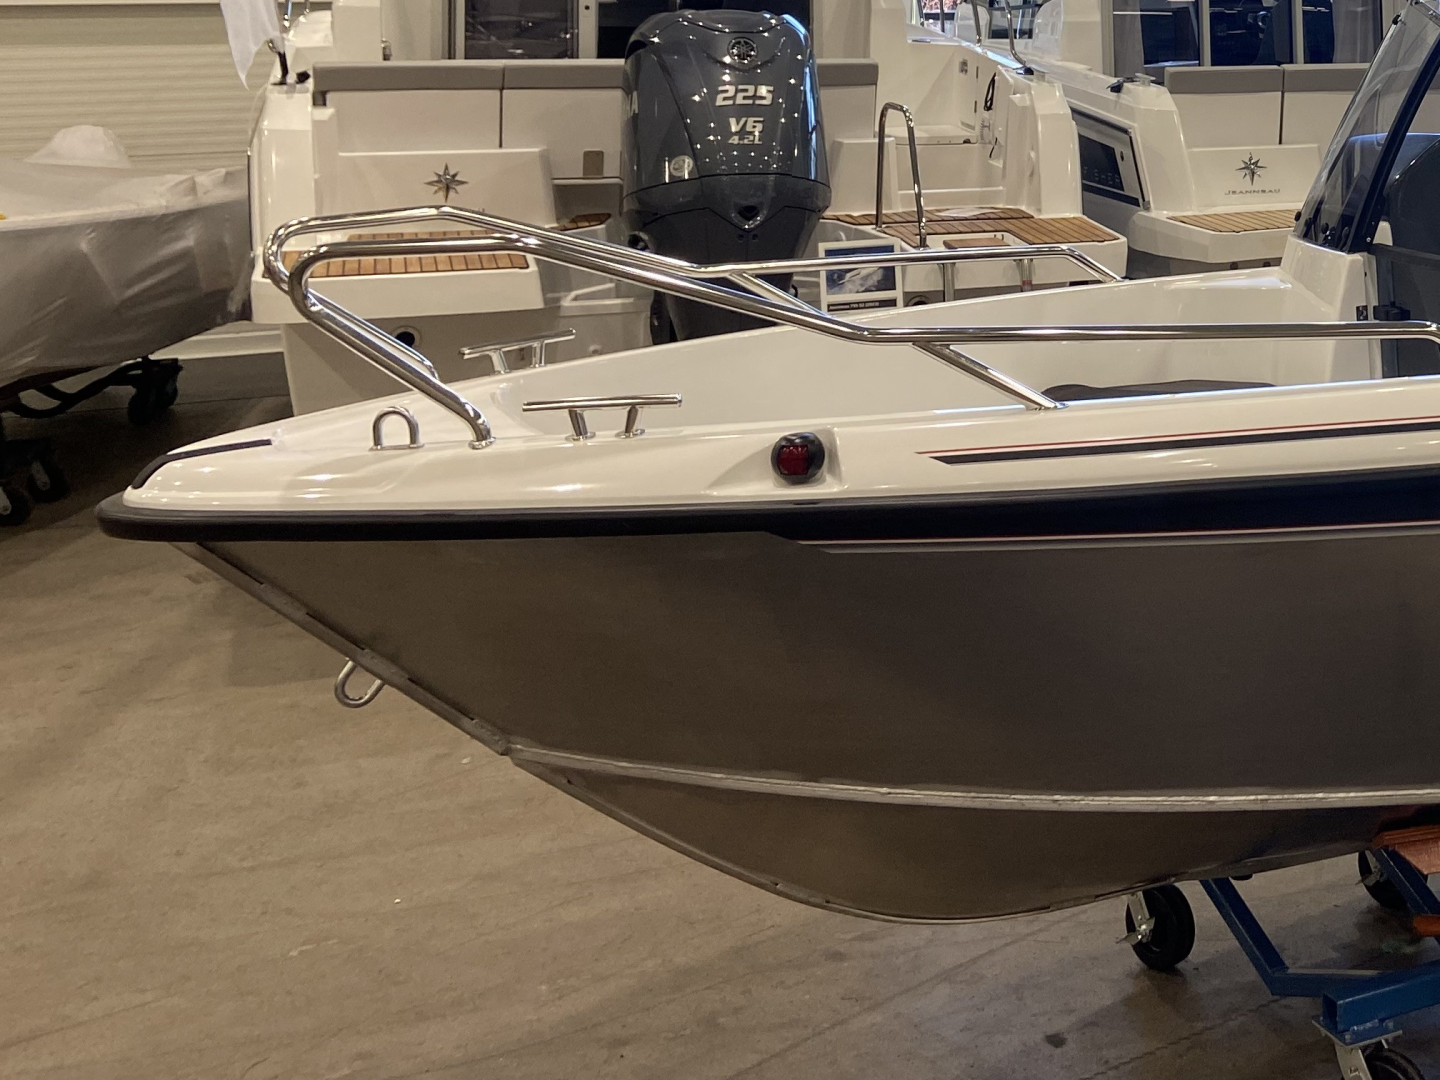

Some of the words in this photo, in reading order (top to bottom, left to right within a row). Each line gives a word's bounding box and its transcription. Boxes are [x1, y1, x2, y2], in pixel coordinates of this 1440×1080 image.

[715, 84, 774, 107] 225
[729, 116, 764, 132] V6
[728, 134, 763, 145] 4.2L
[1224, 188, 1281, 196] JEANNEAU
